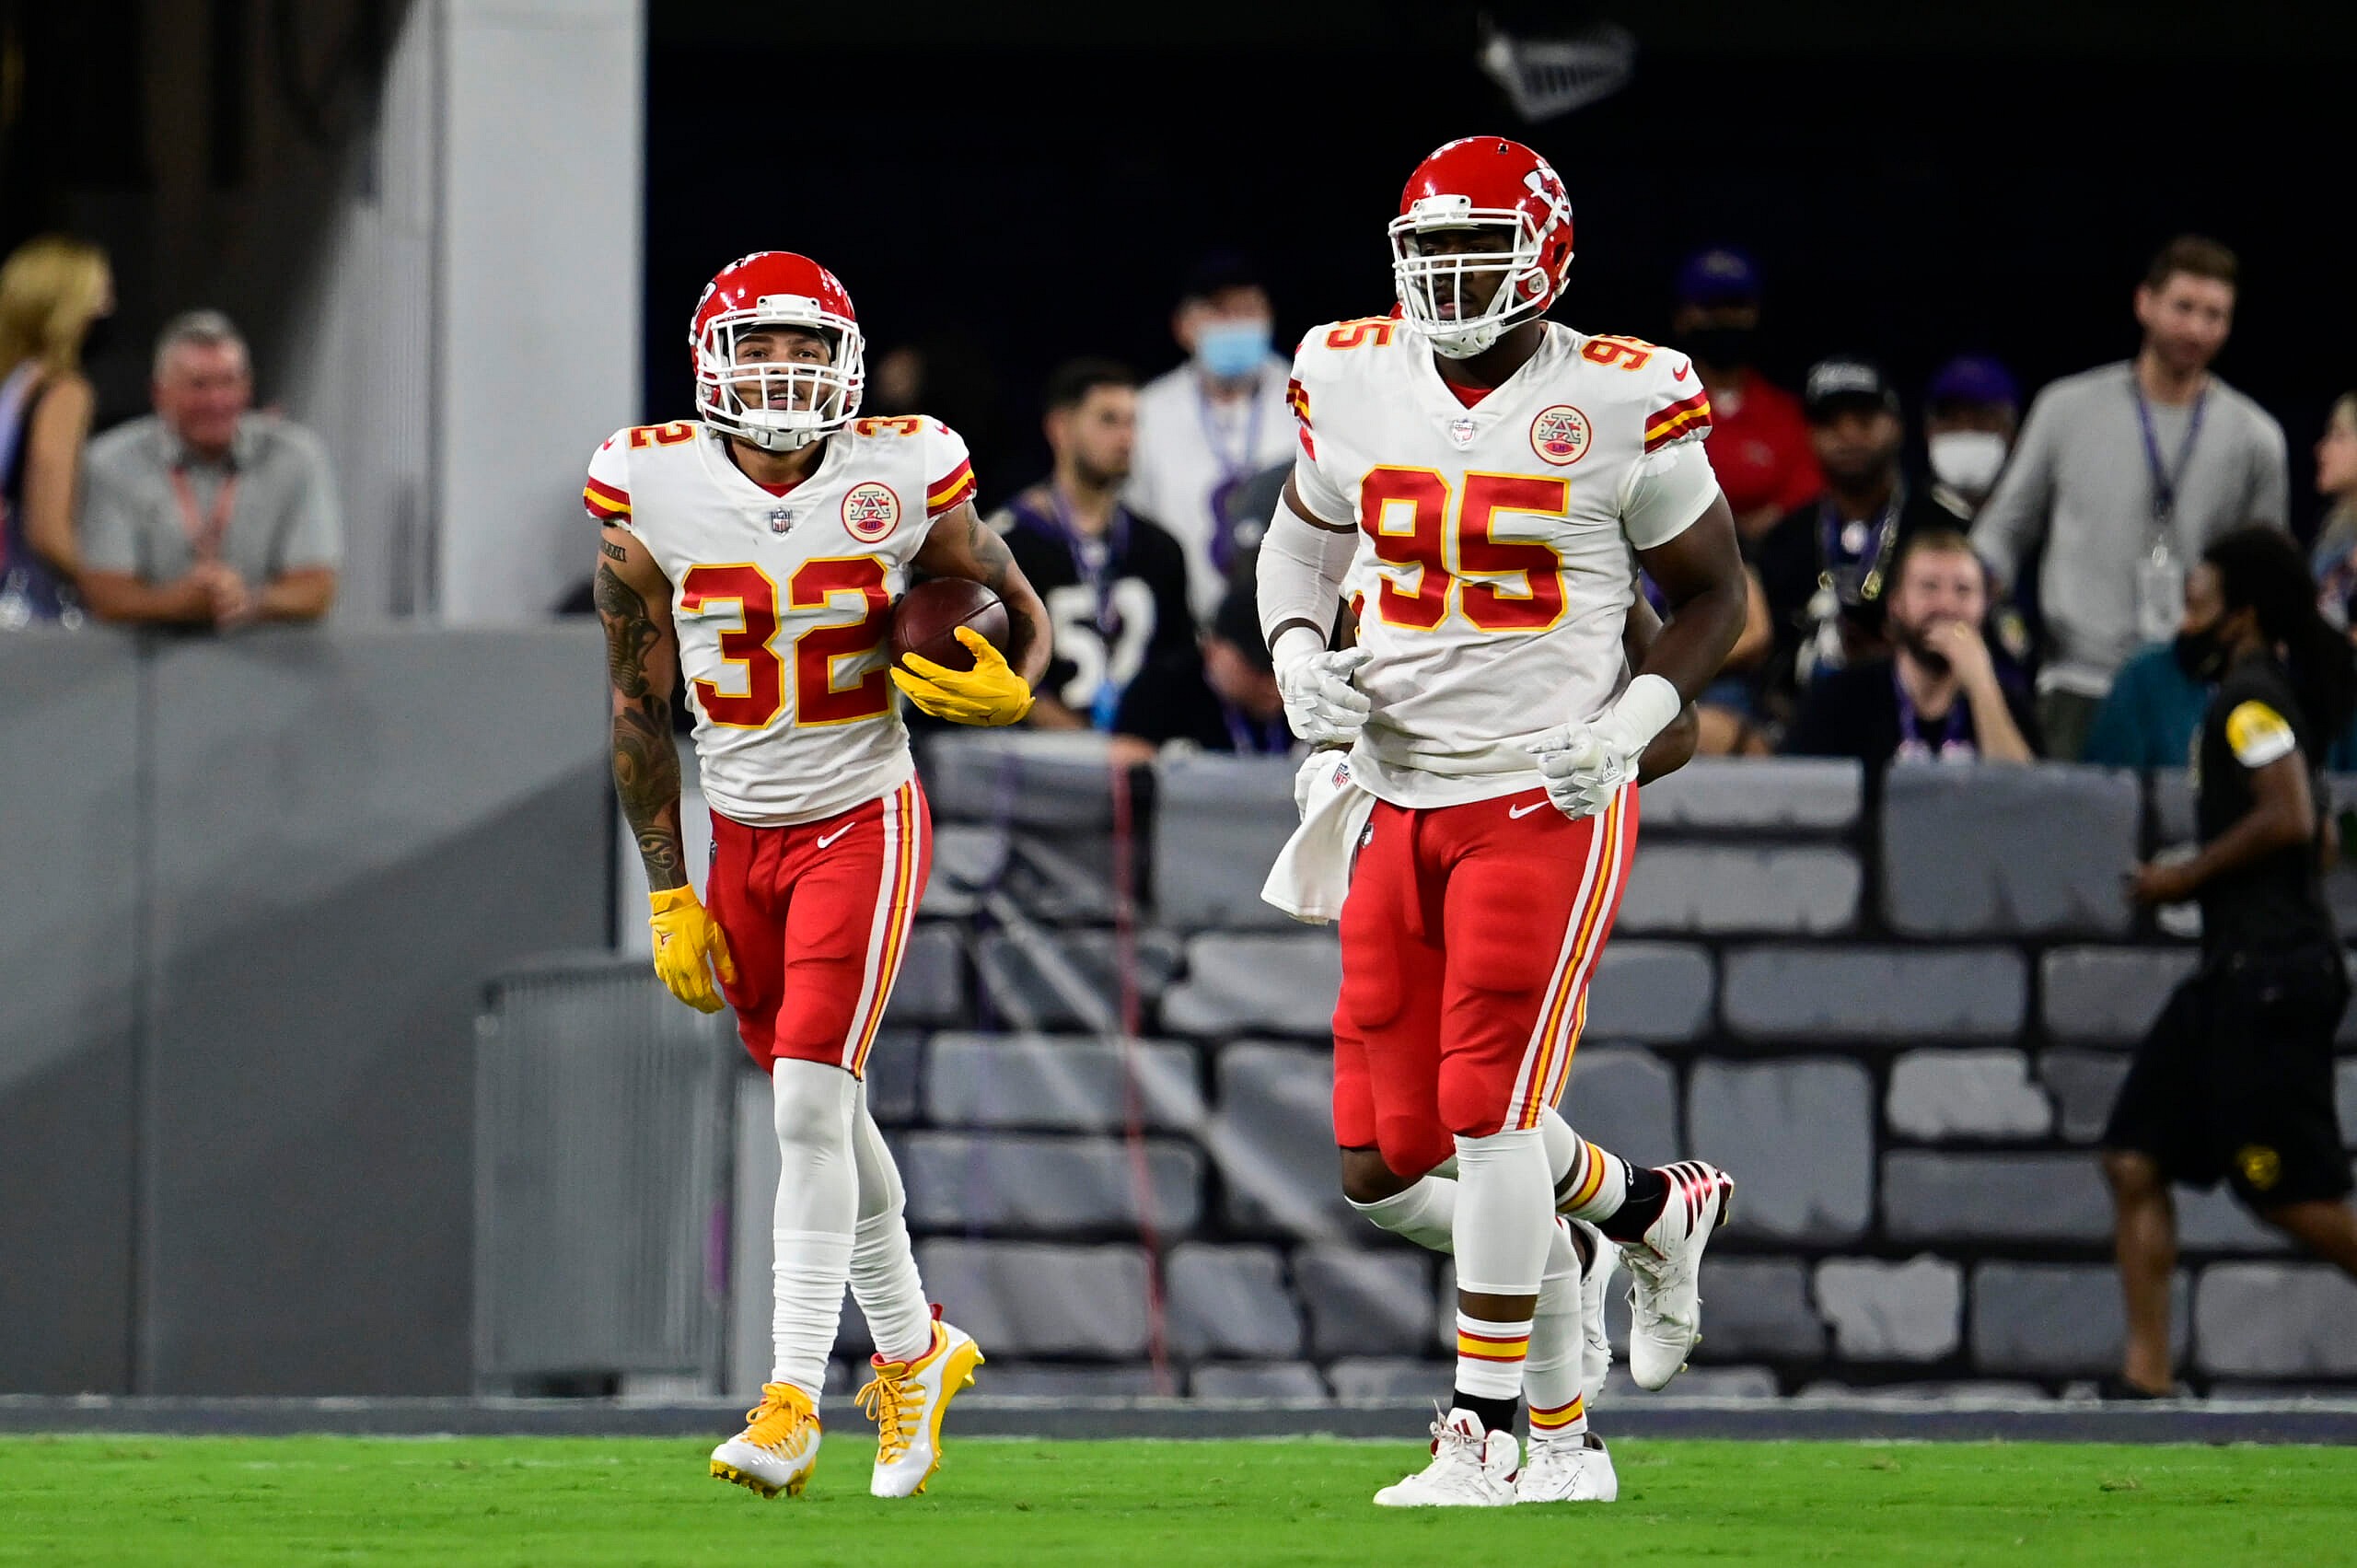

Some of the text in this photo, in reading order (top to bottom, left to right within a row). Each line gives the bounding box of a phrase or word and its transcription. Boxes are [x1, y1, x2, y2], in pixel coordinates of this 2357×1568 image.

[1326, 316, 1397, 351] 5
[1580, 333, 1656, 372] 9
[1361, 463, 1571, 633] 95
[679, 554, 891, 729] 32
